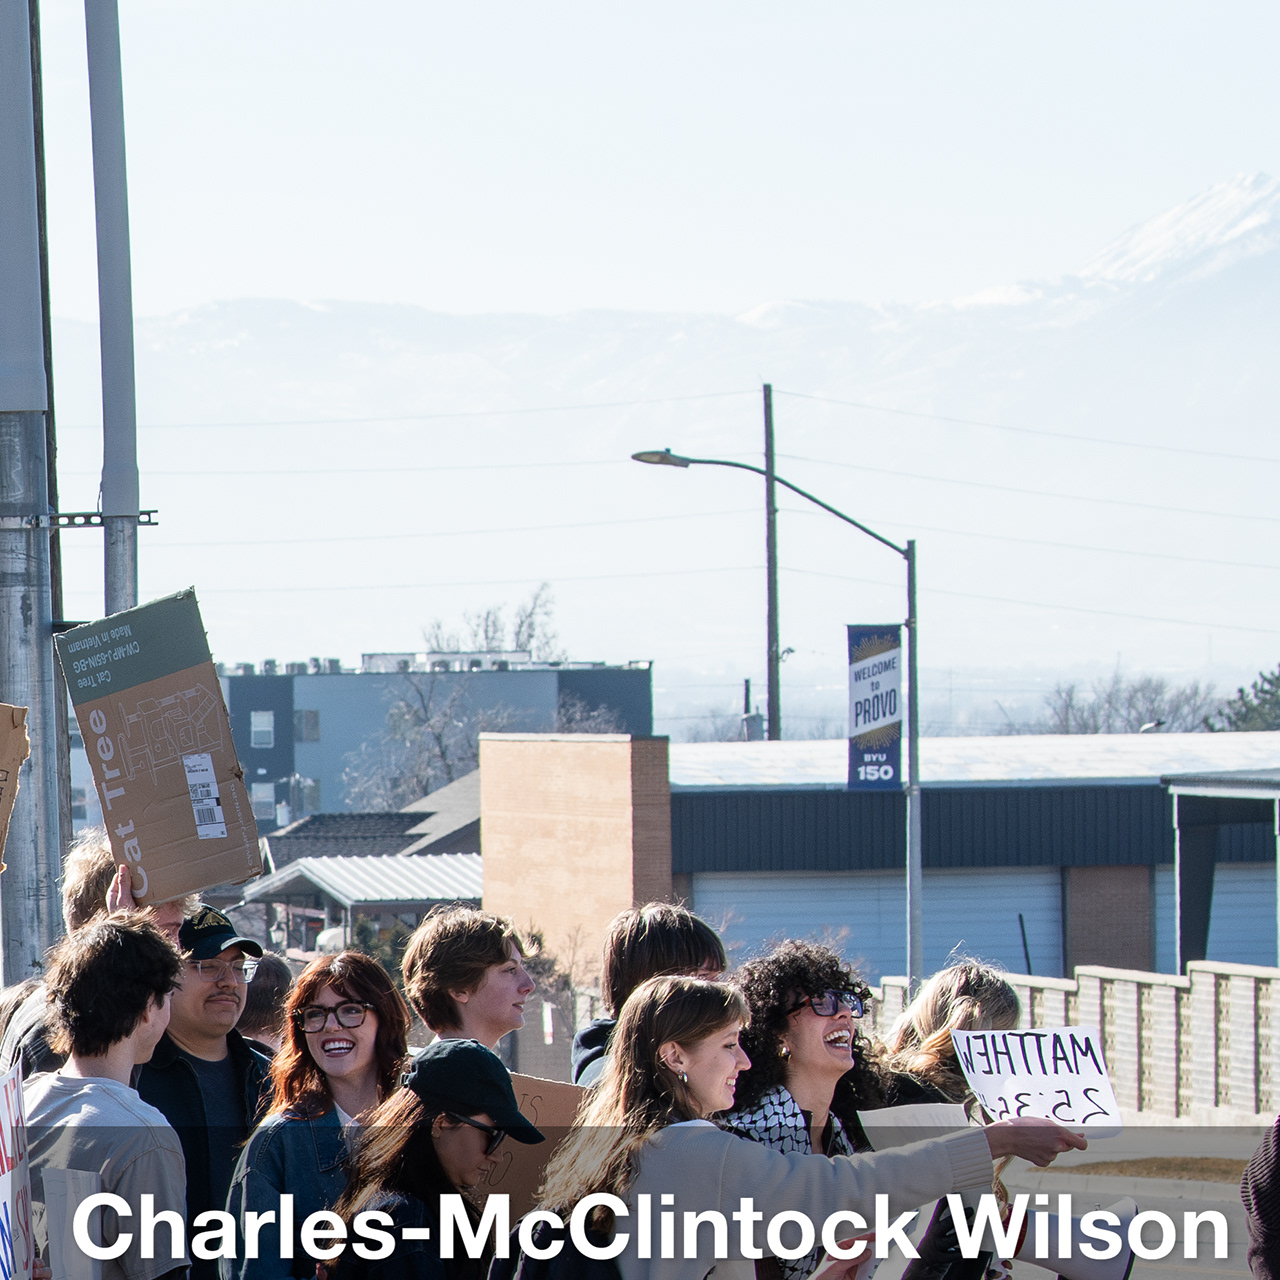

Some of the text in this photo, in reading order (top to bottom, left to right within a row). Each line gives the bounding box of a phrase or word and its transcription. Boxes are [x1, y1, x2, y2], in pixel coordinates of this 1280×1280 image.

[67, 624, 132, 654] Made in Vietnam
[77, 670, 112, 690] Cat Tree
[854, 656, 896, 682] WELCOME
[871, 680, 880, 692] to
[854, 688, 897, 728] PROVO
[864, 753, 887, 762] BYU
[857, 765, 894, 780] 150
[89, 708, 149, 898] Cat Tree
